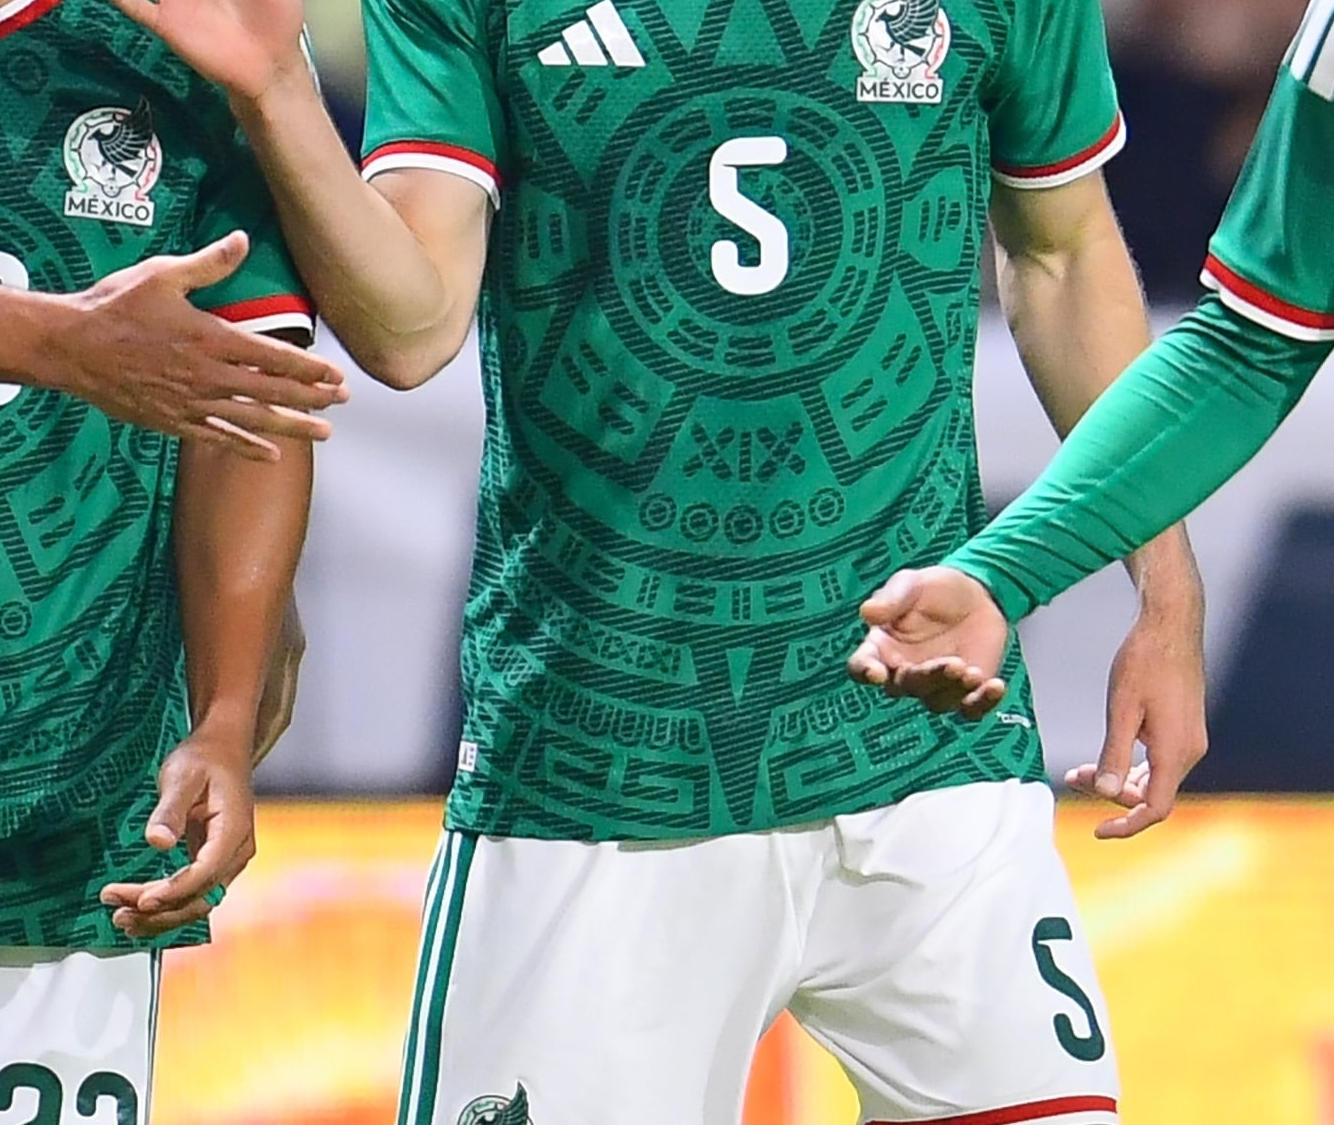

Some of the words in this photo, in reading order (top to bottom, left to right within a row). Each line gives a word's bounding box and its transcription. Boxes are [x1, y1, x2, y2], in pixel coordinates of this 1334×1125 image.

[860, 77, 939, 99] MÉXICO
[67, 194, 150, 221] MÉXICO
[709, 136, 789, 295] 5
[1032, 917, 1105, 1061] 5
